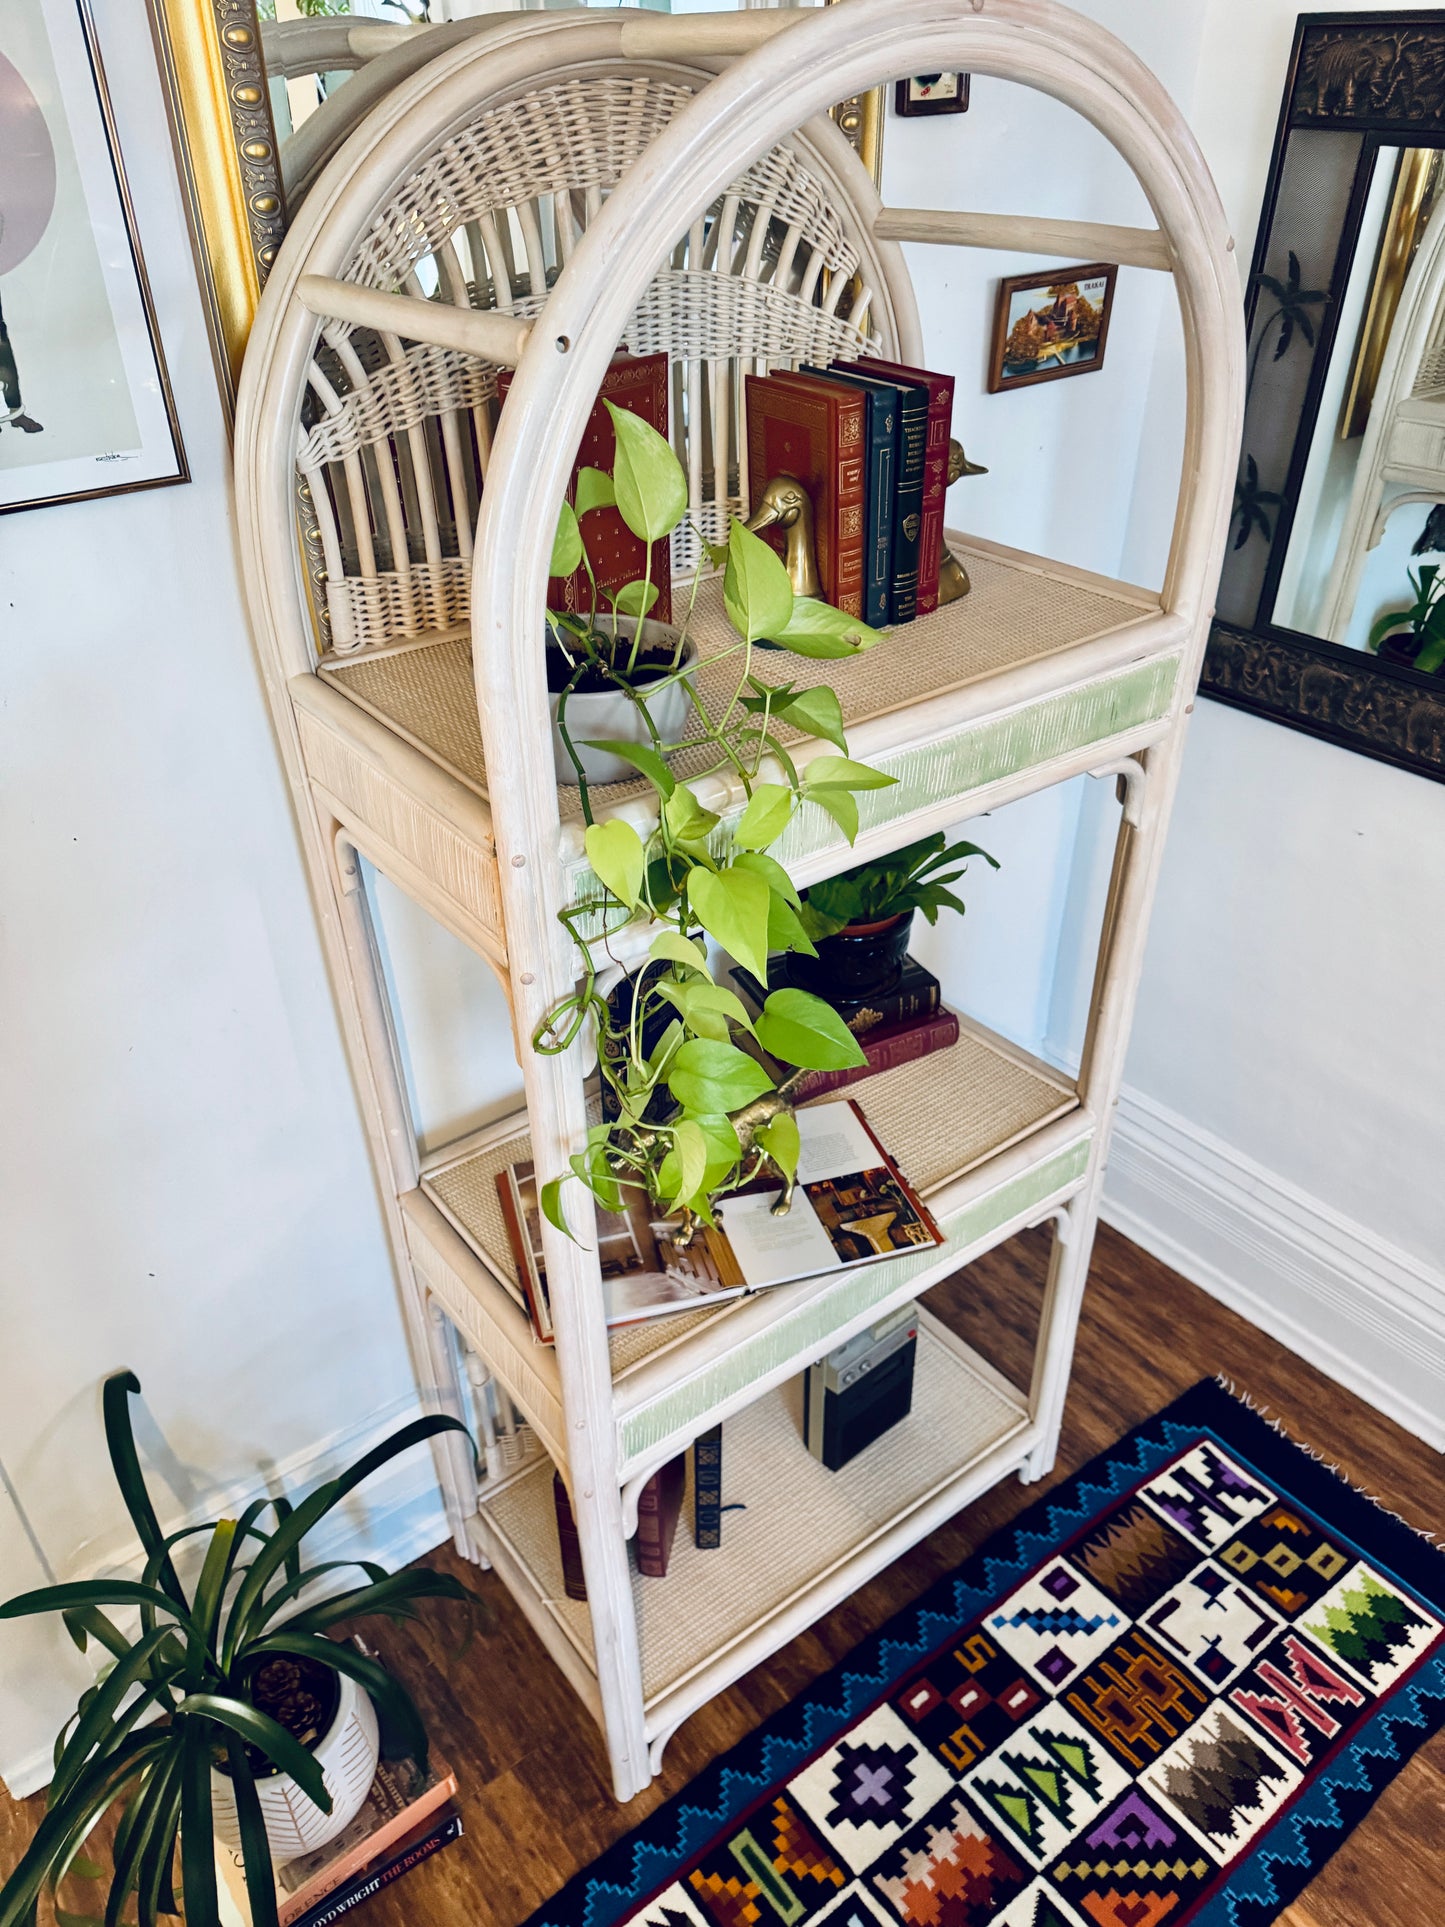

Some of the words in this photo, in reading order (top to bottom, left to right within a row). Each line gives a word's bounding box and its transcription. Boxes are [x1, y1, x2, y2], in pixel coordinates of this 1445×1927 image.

[336, 1877, 381, 1913] WRIGHT
[381, 1864, 406, 1883] THE
[403, 1837, 441, 1869] ROOMS
